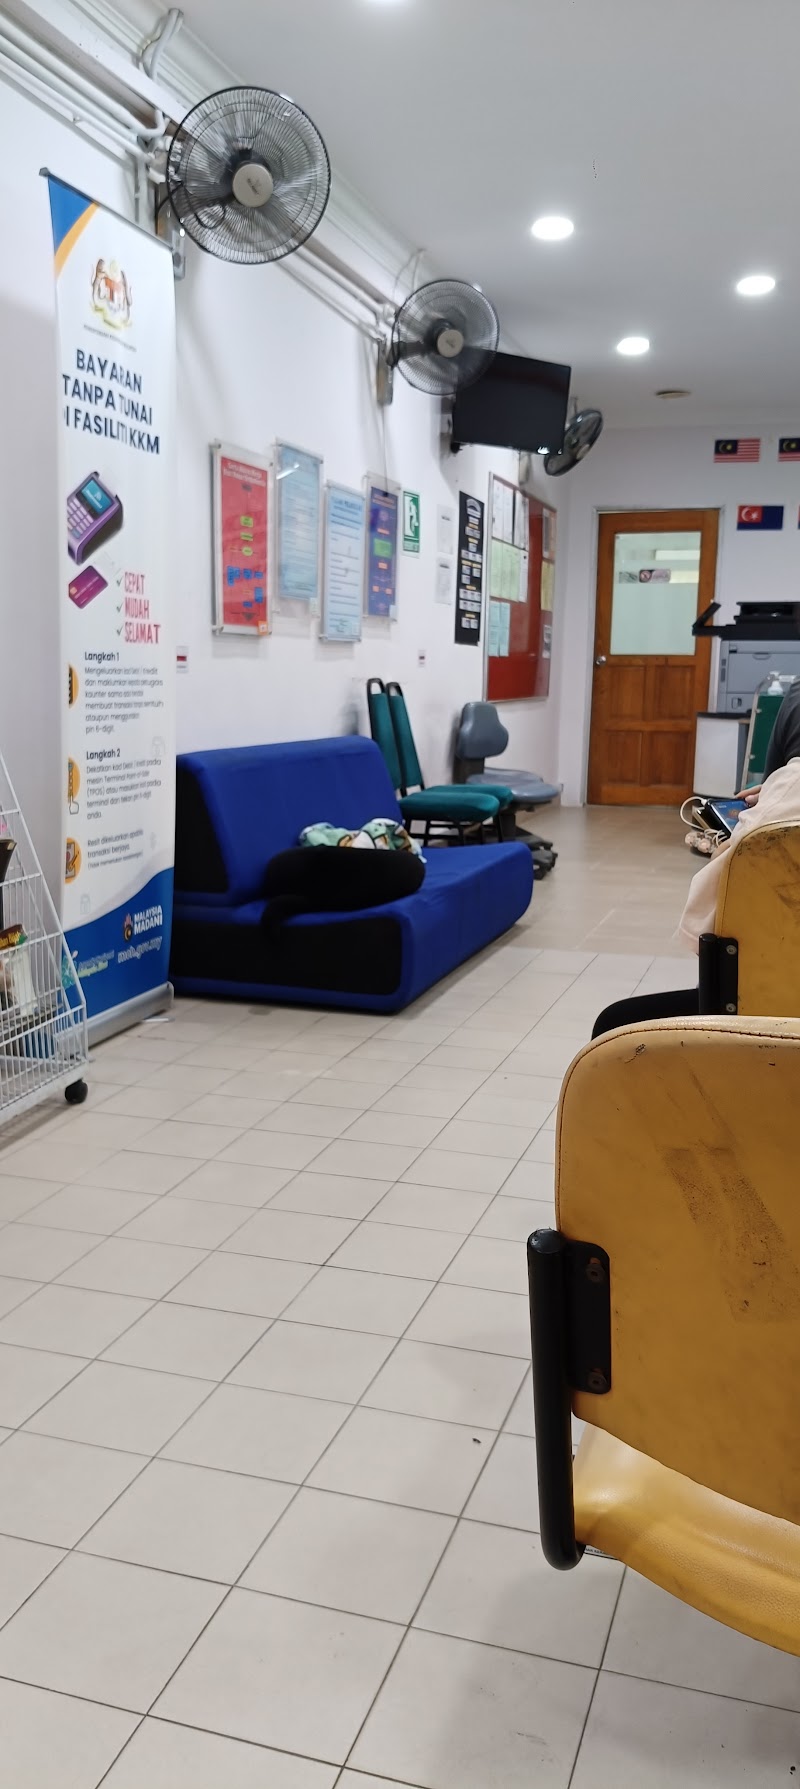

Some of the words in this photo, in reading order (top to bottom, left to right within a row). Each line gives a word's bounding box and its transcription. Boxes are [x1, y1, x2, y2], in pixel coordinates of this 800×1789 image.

[76, 348, 142, 395] BAYARAN
[62, 373, 116, 411] TANPA
[118, 393, 153, 426] TUNAI
[74, 408, 128, 444] FASILITI
[129, 427, 160, 455] KKM
[124, 571, 146, 595] CEPAT
[124, 597, 150, 620] MUDAH
[124, 621, 161, 644] SELAMAT
[84, 651, 115, 664] Langkah
[116, 652, 120, 661] 1
[86, 748, 115, 762] Langkah
[116, 748, 121, 758] 2
[134, 904, 163, 922] MALAYSIA
[134, 914, 163, 935] MADANI
